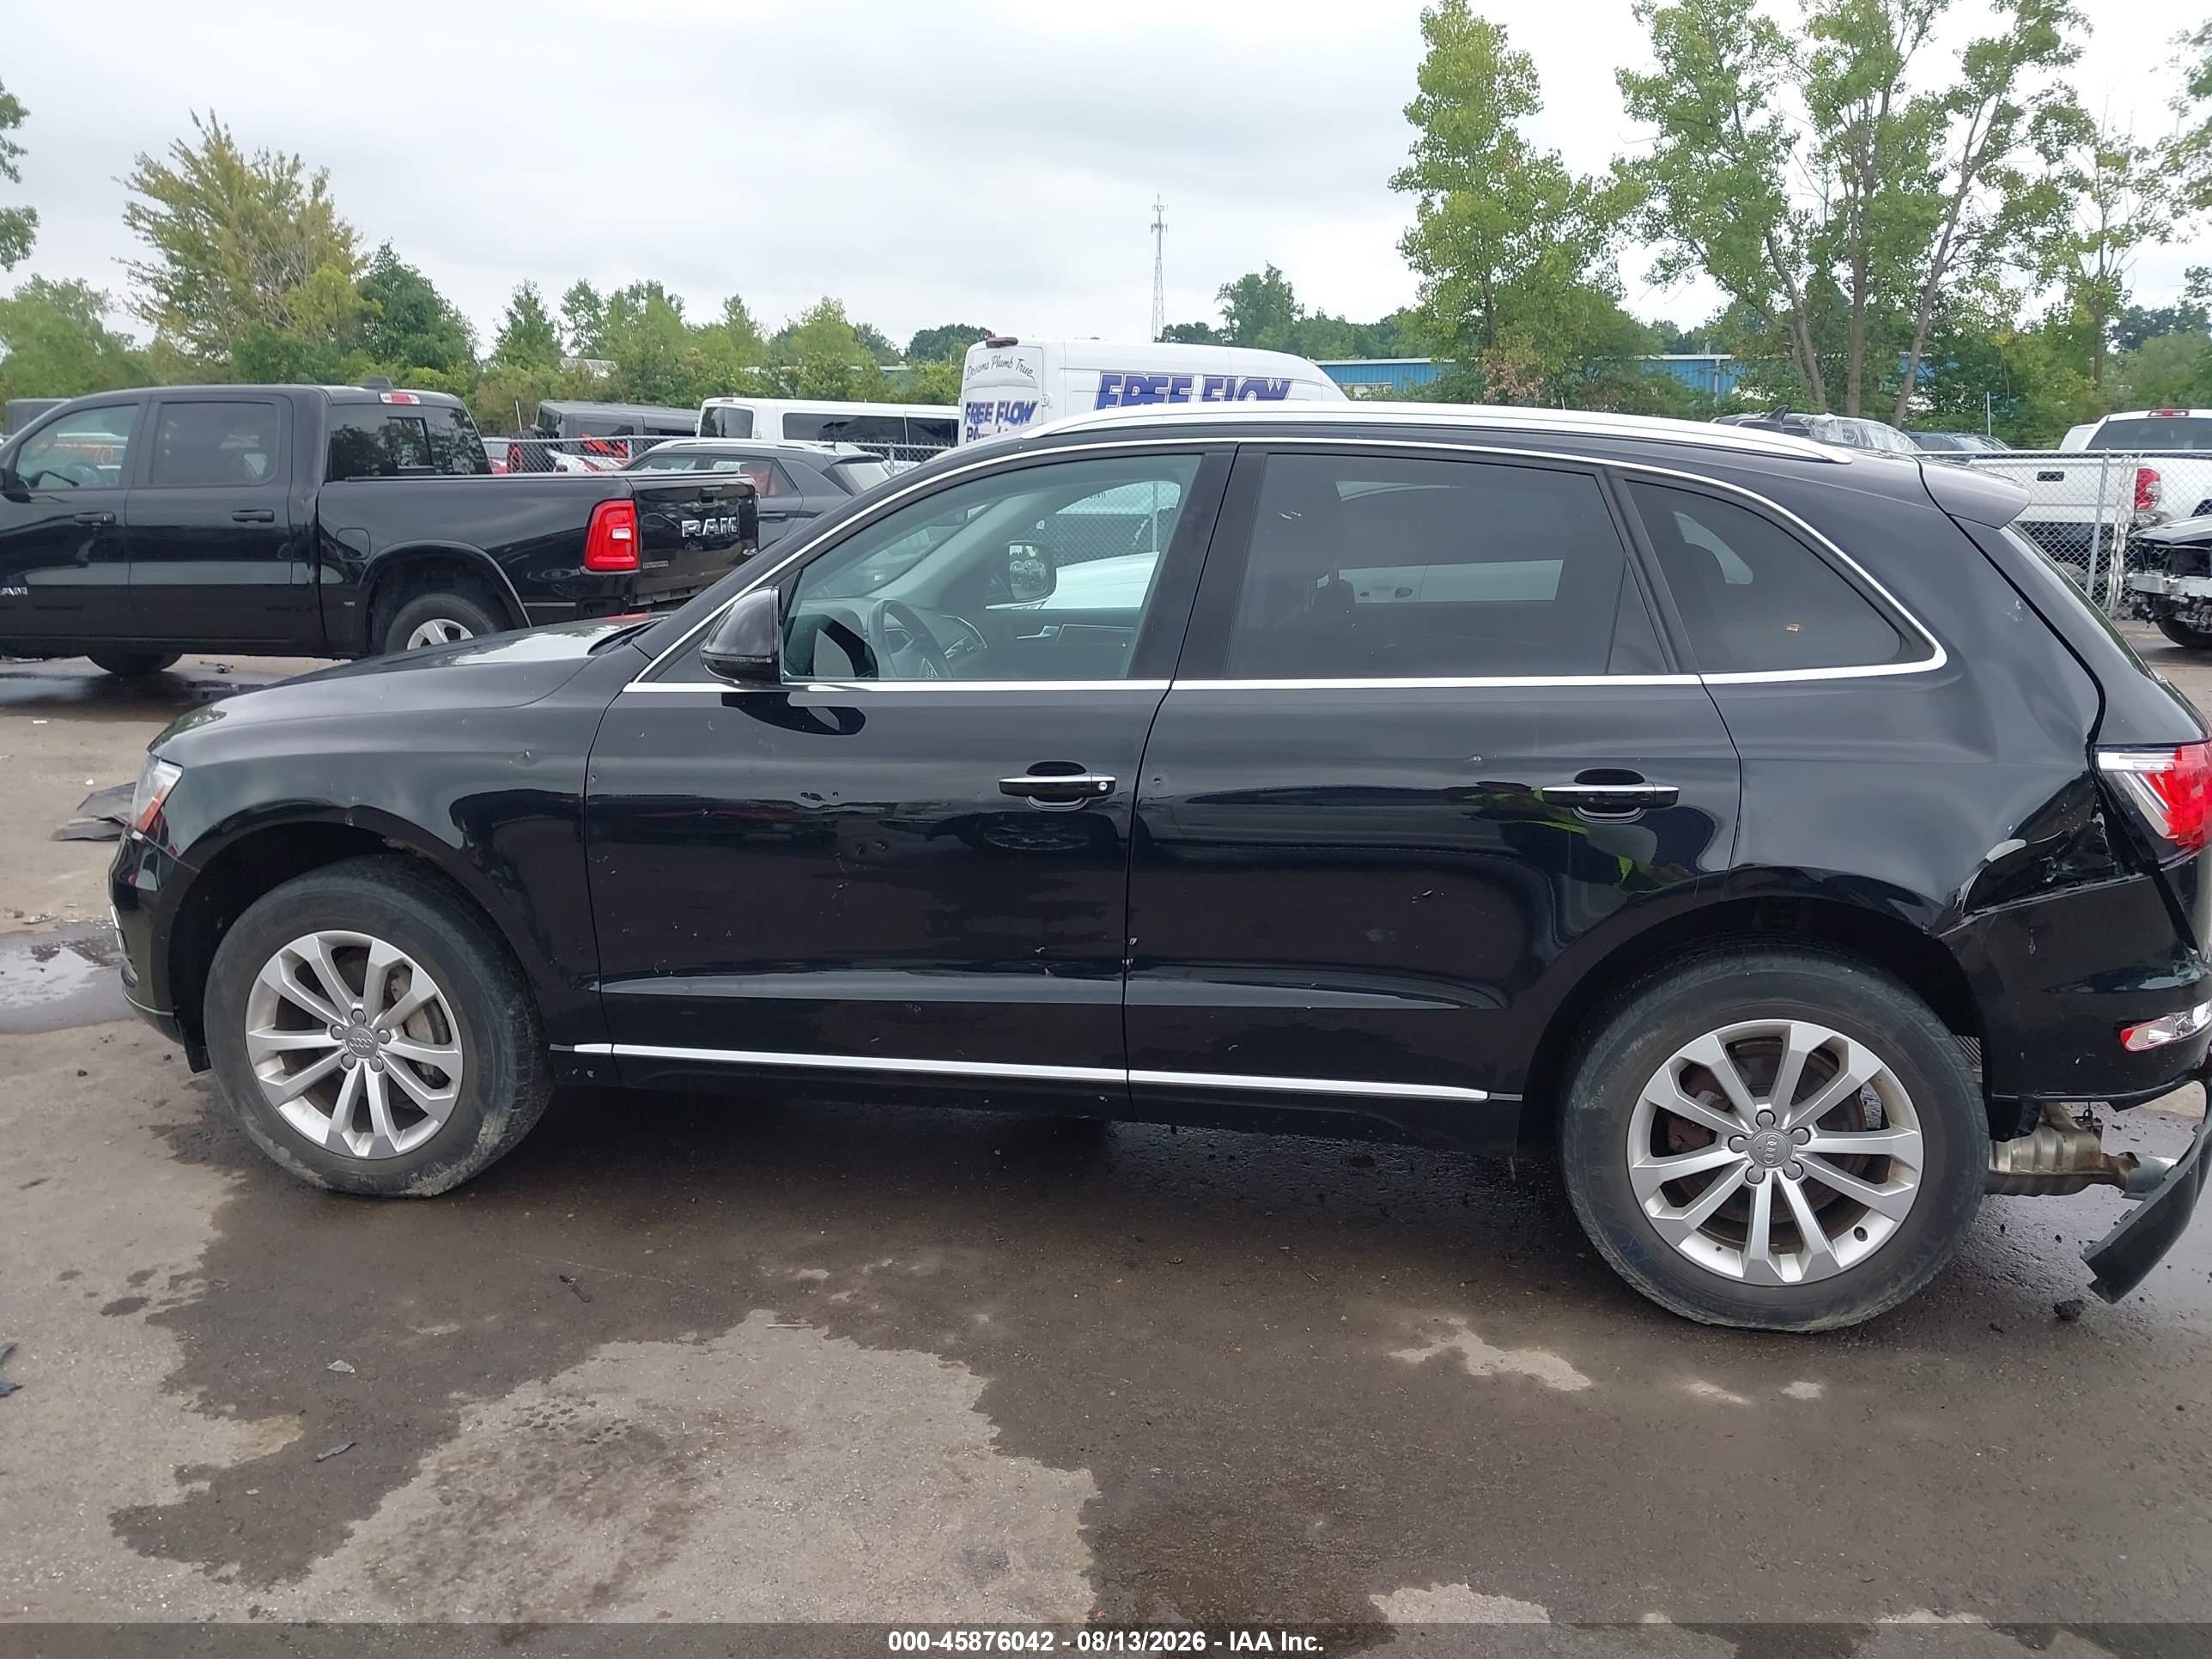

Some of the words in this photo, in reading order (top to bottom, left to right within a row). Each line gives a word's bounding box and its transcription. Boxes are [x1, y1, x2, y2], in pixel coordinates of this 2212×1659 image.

[991, 355, 1013, 369] Plumb
[1016, 358, 1036, 383] True
[1093, 372, 1194, 410] FREE
[963, 401, 994, 426] FREE
[995, 400, 1037, 426] FLOW
[682, 517, 738, 538] RAM
[0, 586, 28, 596] AM
